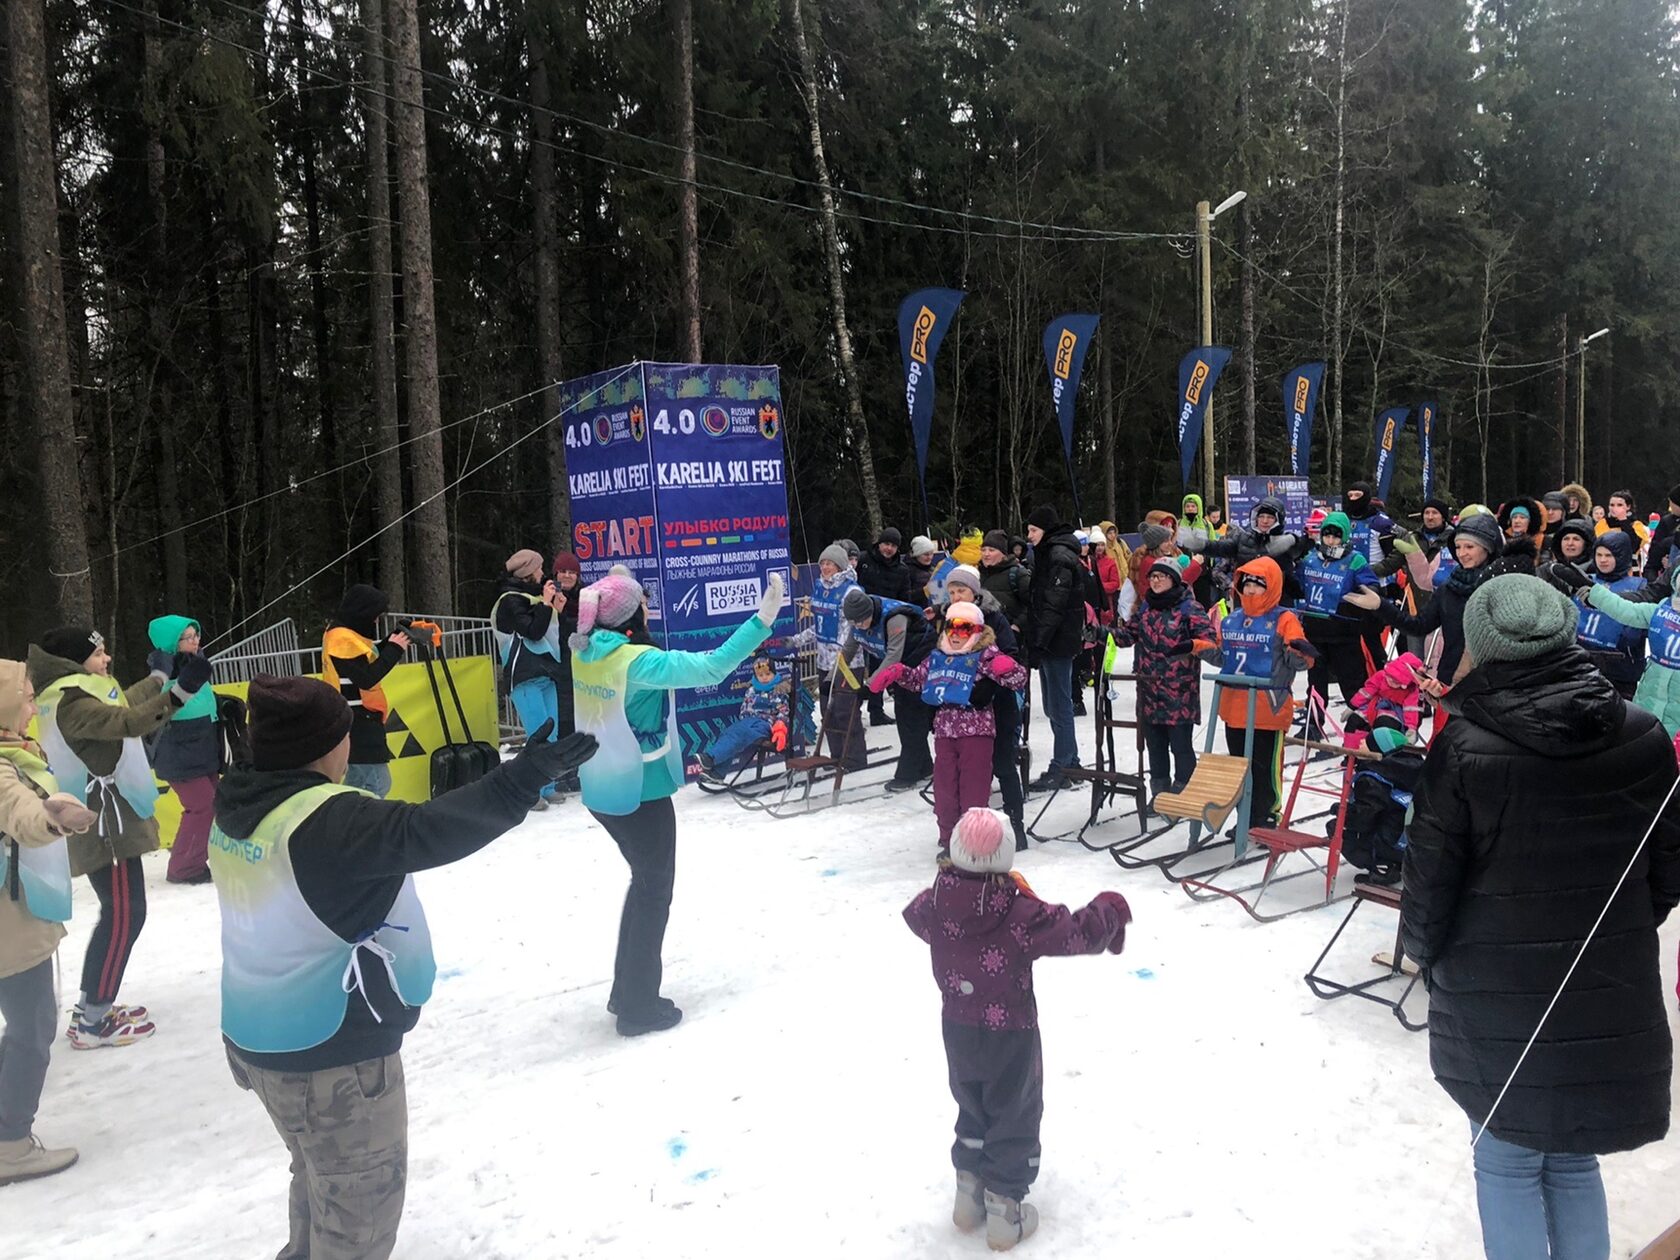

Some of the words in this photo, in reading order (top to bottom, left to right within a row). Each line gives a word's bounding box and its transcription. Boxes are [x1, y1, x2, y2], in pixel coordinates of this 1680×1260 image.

[914, 313, 931, 359] PRO
[1057, 335, 1073, 375] PRO
[1188, 365, 1206, 401] PRO
[1296, 380, 1308, 411] PRO
[653, 408, 696, 435] 4.0
[730, 407, 756, 417] RUSSIAN
[731, 416, 751, 425] EVENT
[566, 421, 592, 449] 4.0
[732, 424, 758, 434] AWARDS
[1383, 420, 1393, 448] PRO
[569, 469, 613, 496] KARELIA
[613, 466, 627, 490] SKI
[628, 463, 649, 488] FEST
[657, 461, 725, 486] KARELIA
[728, 460, 748, 483] SKI
[751, 459, 782, 482] FEST
[575, 515, 655, 560] START
[722, 549, 760, 564] MARATHONS
[760, 548, 768, 560] OF
[667, 566, 697, 581] ЛЫЖНЫЕ
[710, 583, 757, 599] RUSSIA
[711, 595, 757, 610] LOPPET
[1310, 585, 1323, 604] 14
[1584, 613, 1600, 635] 11
[1235, 652, 1247, 675] 2
[956, 672, 973, 683] FEST
